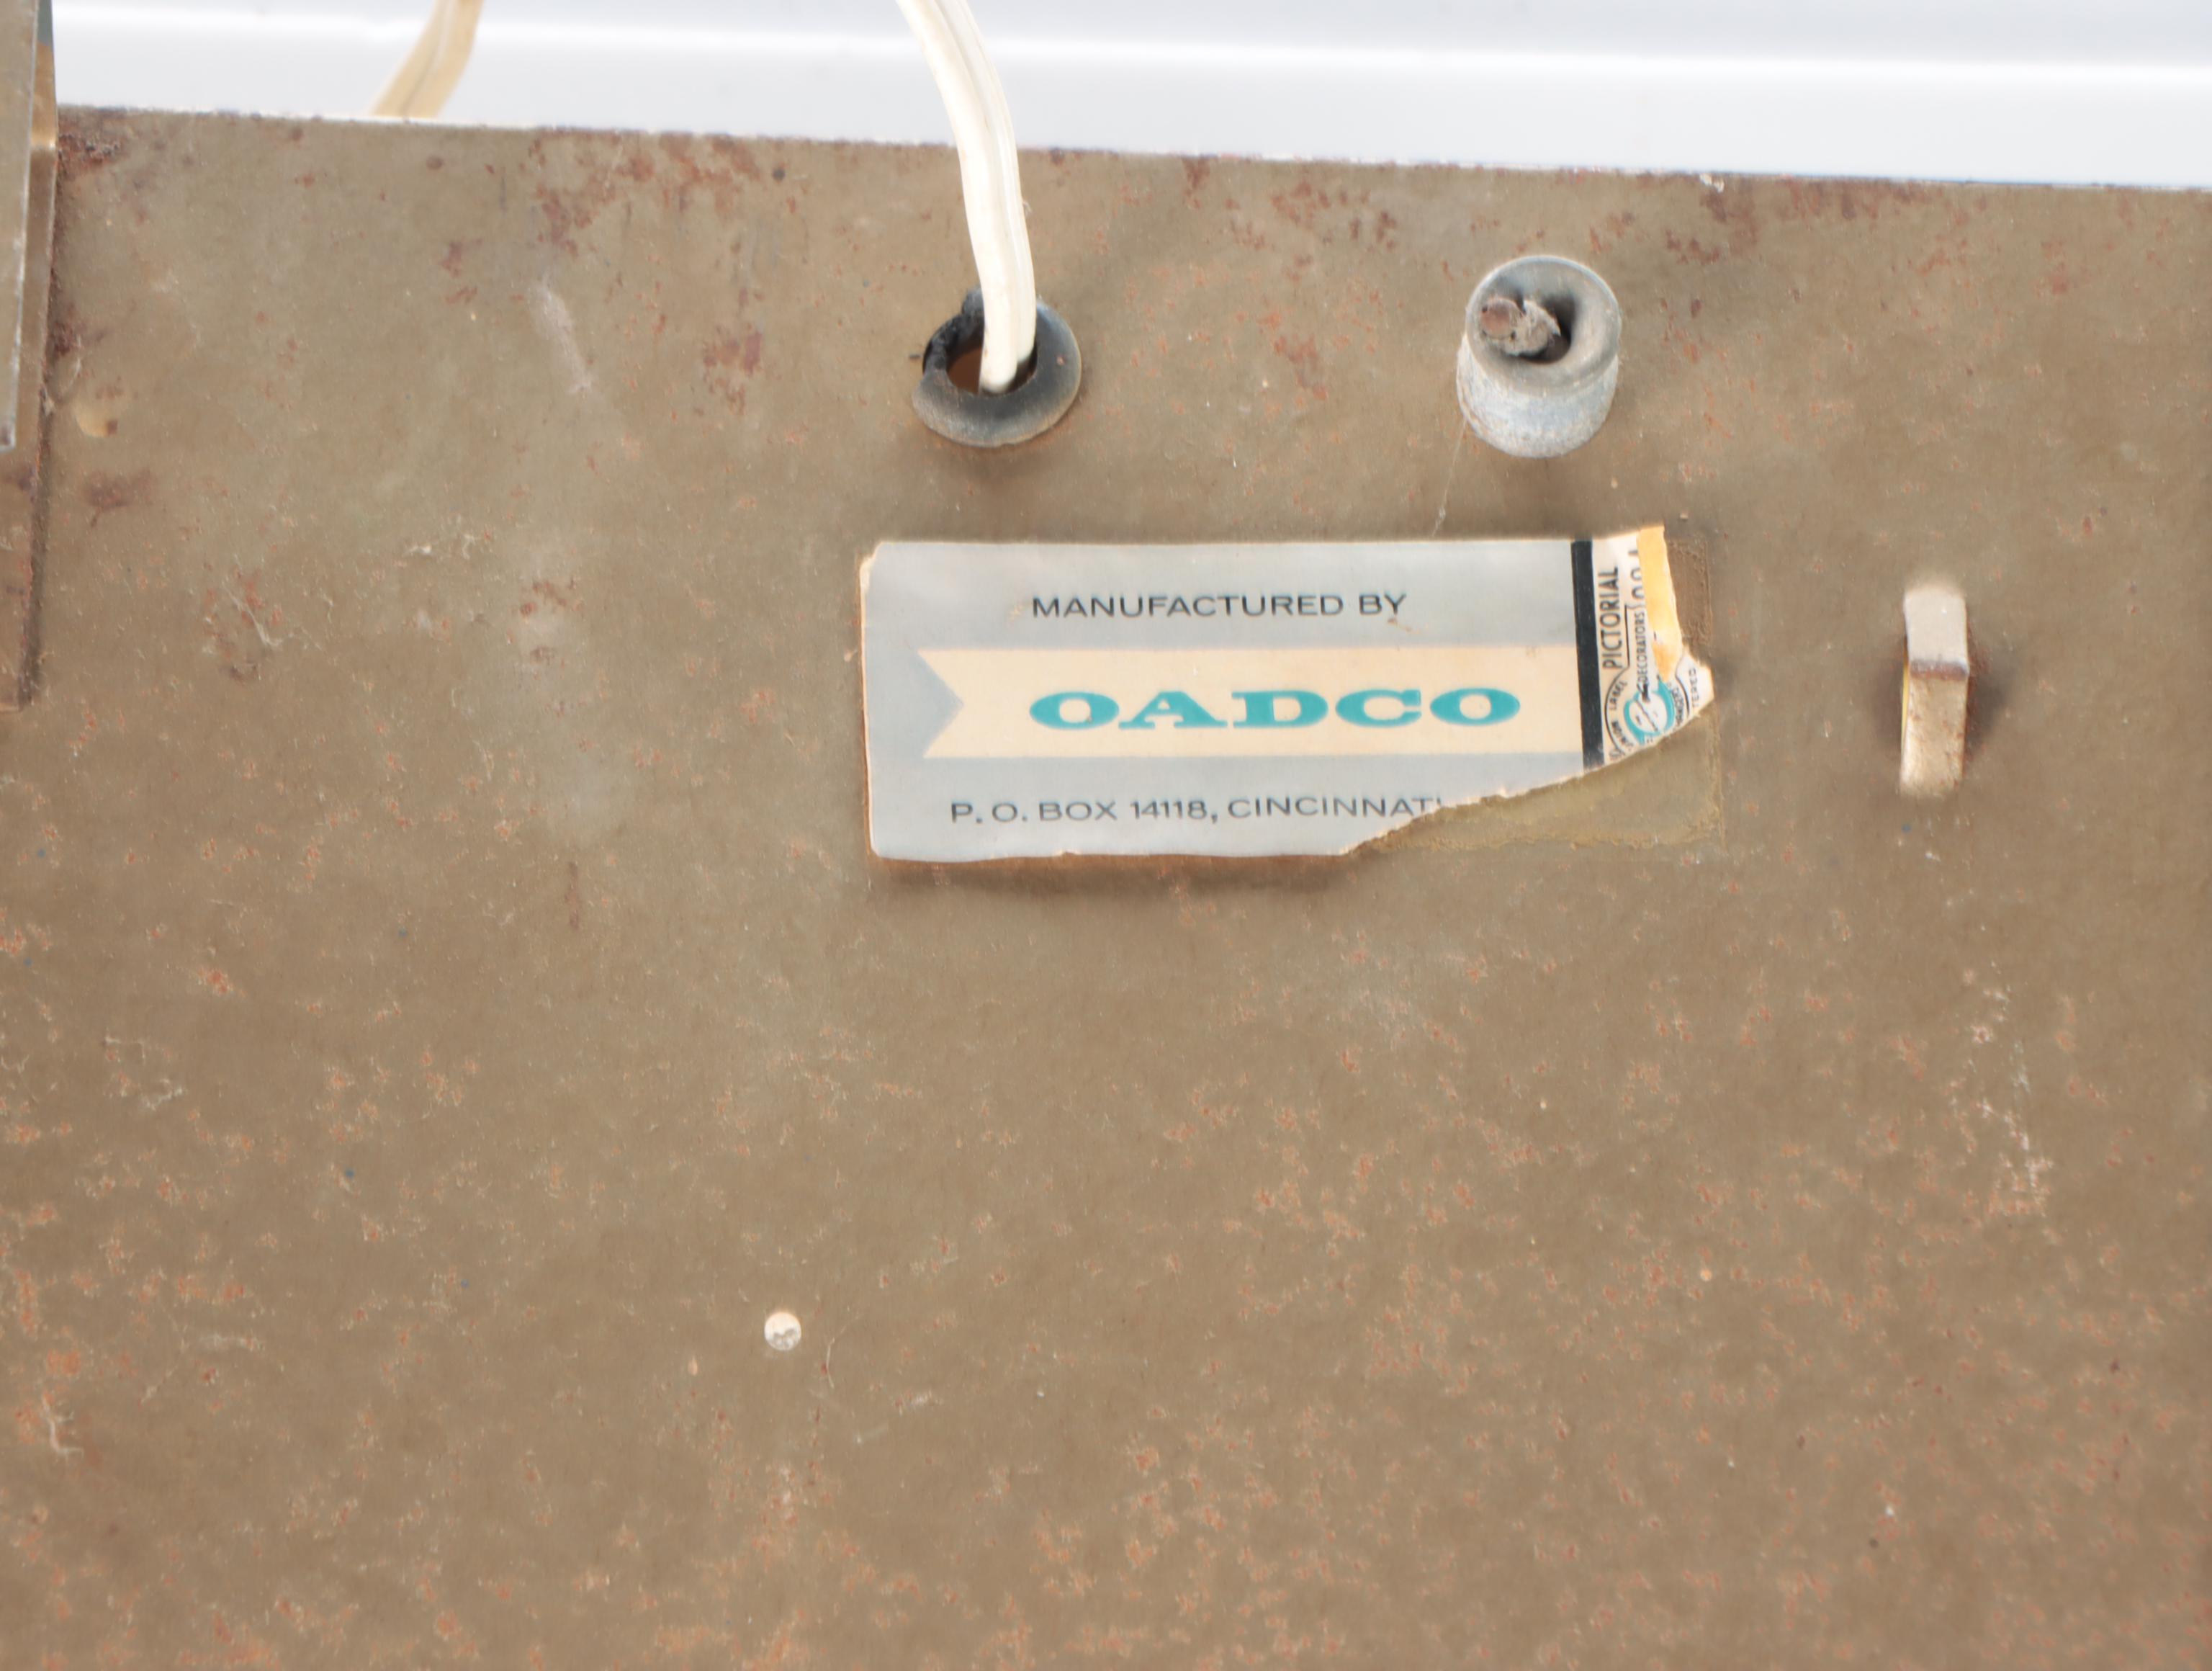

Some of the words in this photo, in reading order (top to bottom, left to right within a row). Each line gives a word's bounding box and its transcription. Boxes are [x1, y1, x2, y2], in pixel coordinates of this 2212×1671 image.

[1031, 595, 1344, 619] MANUFACTURED
[1357, 593, 1408, 616] BY
[1598, 567, 1622, 669] PICTORIAL
[1634, 611, 1648, 683] DECORATORS
[1029, 689, 1521, 730] OADCO
[1609, 680, 1627, 710] LABEL
[1038, 801, 1118, 821] BOX
[1130, 799, 1218, 824] 14118,
